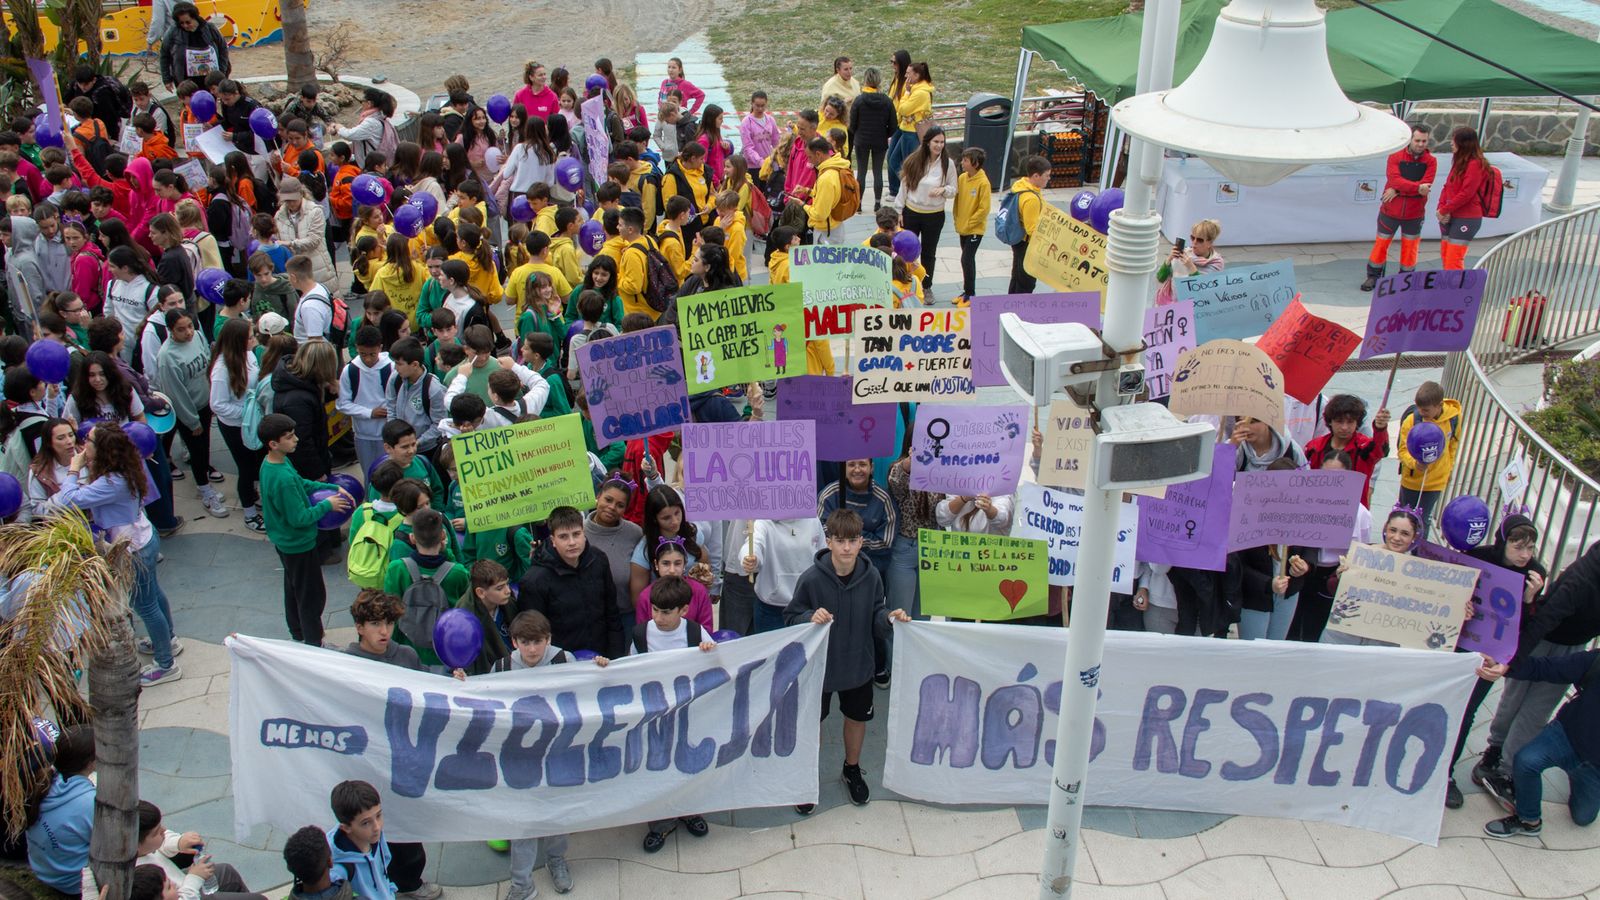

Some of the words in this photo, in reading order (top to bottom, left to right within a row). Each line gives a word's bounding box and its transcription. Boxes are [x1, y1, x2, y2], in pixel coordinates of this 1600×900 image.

[794, 248, 811, 266] LA
[815, 288, 838, 303] UNA
[841, 285, 873, 301] FORMA
[1377, 278, 1396, 298] EL
[686, 294, 731, 328] MAMÁ
[980, 301, 993, 313] DE
[1003, 300, 1047, 311] CAMINO
[863, 315, 883, 332] ES
[889, 314, 912, 331] UN
[919, 310, 967, 333] PAIS
[1154, 309, 1175, 328] LA
[688, 332, 705, 351] LA
[707, 324, 738, 345] CAPA
[741, 321, 764, 337] DEL
[861, 335, 893, 353] TAN
[899, 333, 957, 354] POBRE
[858, 355, 903, 373] GRITA
[918, 357, 961, 371] FUERTE
[893, 381, 913, 393] QUE
[456, 429, 515, 455] TRUMP
[684, 424, 710, 449] NO
[712, 423, 734, 449] TE
[738, 422, 805, 449] CALLES
[688, 451, 728, 484] LA
[753, 450, 813, 482] LUCHA
[1055, 458, 1079, 471] LAS
[1244, 474, 1278, 488] PARA
[1288, 474, 1345, 488] CONSEGUIR
[485, 496, 499, 508] HAY
[500, 493, 518, 504] NADA
[685, 485, 708, 513] ES
[708, 485, 749, 512] COSA
[748, 485, 769, 511] DE
[768, 484, 816, 510] TODOS
[1043, 490, 1064, 515] Oigo
[473, 515, 494, 527] QUE
[496, 511, 511, 522] UNA
[920, 530, 936, 543] EL
[920, 560, 939, 571] DE
[948, 562, 962, 572] LA
[1352, 547, 1395, 573] PARA
[1363, 610, 1425, 634] LABORAL
[266, 721, 353, 753] MENOS
[384, 640, 809, 799] VIOLENCIA
[1132, 684, 1450, 795] RESPETO
